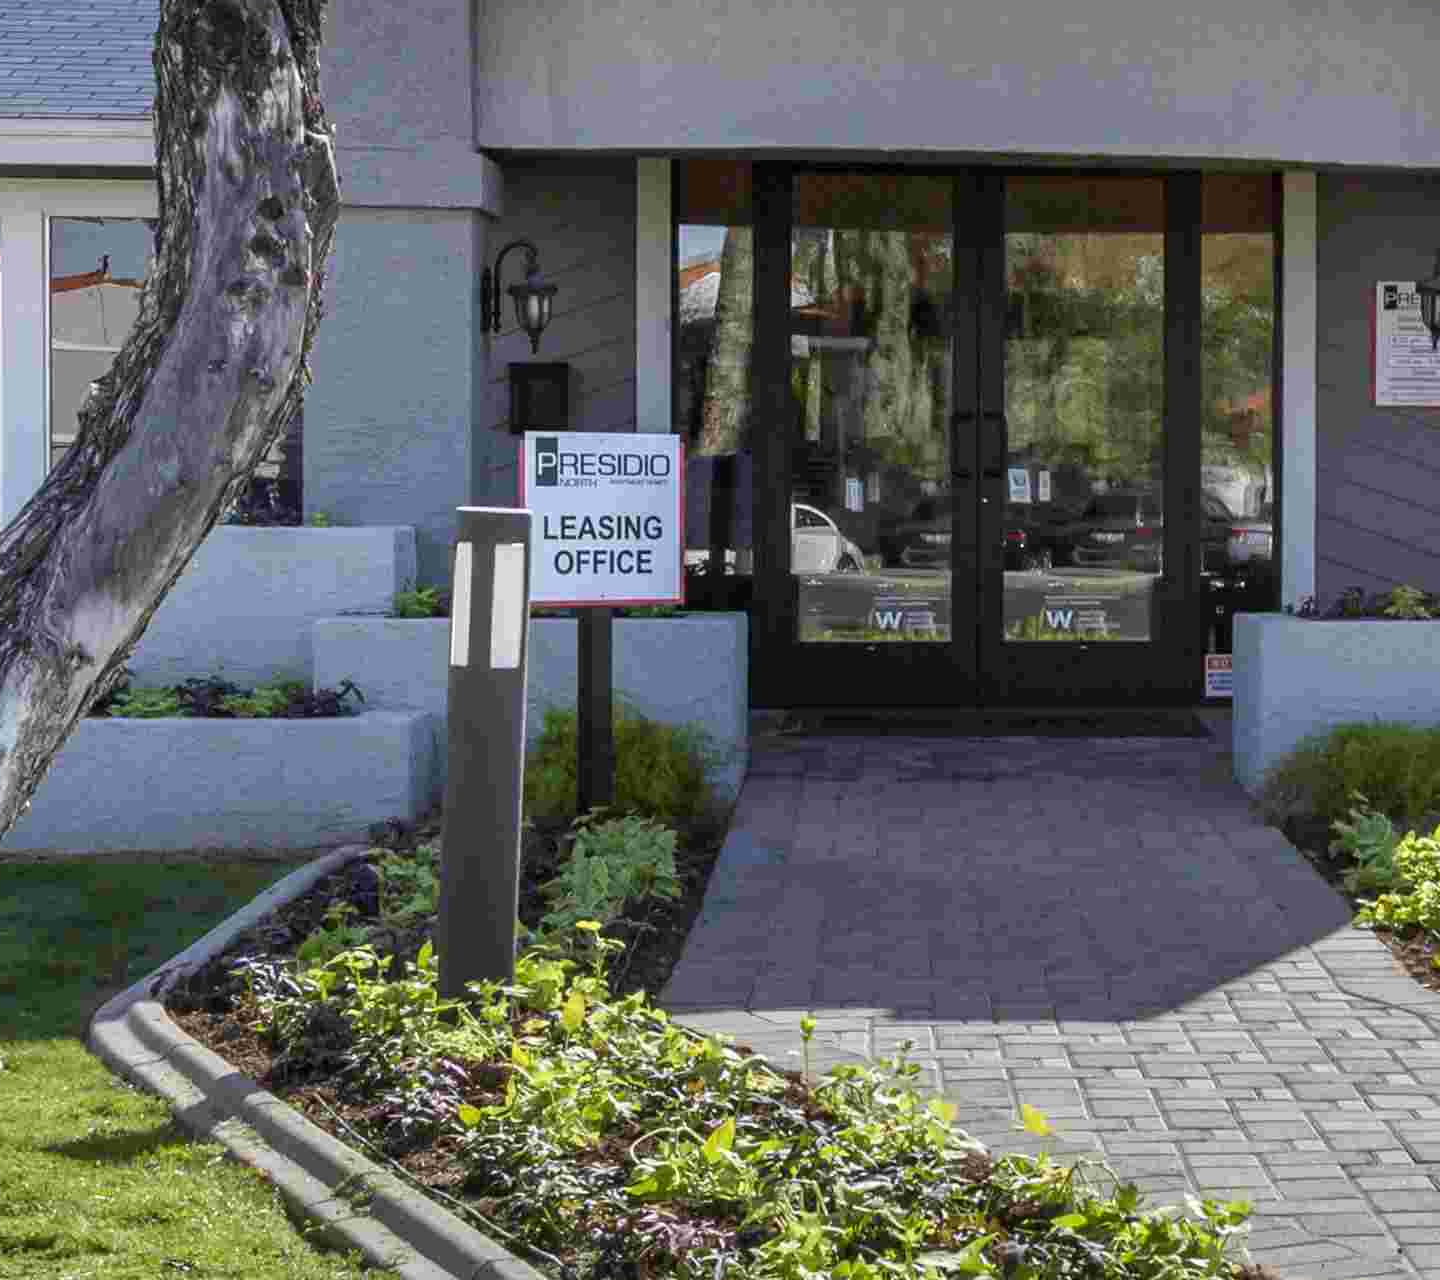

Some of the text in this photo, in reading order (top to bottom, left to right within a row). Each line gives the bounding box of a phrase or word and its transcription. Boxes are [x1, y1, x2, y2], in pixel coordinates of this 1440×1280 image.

[537, 451, 671, 477] PRESIDIO
[560, 478, 598, 488] NORTH
[543, 515, 663, 541] LEASING
[554, 549, 653, 575] OFFICE
